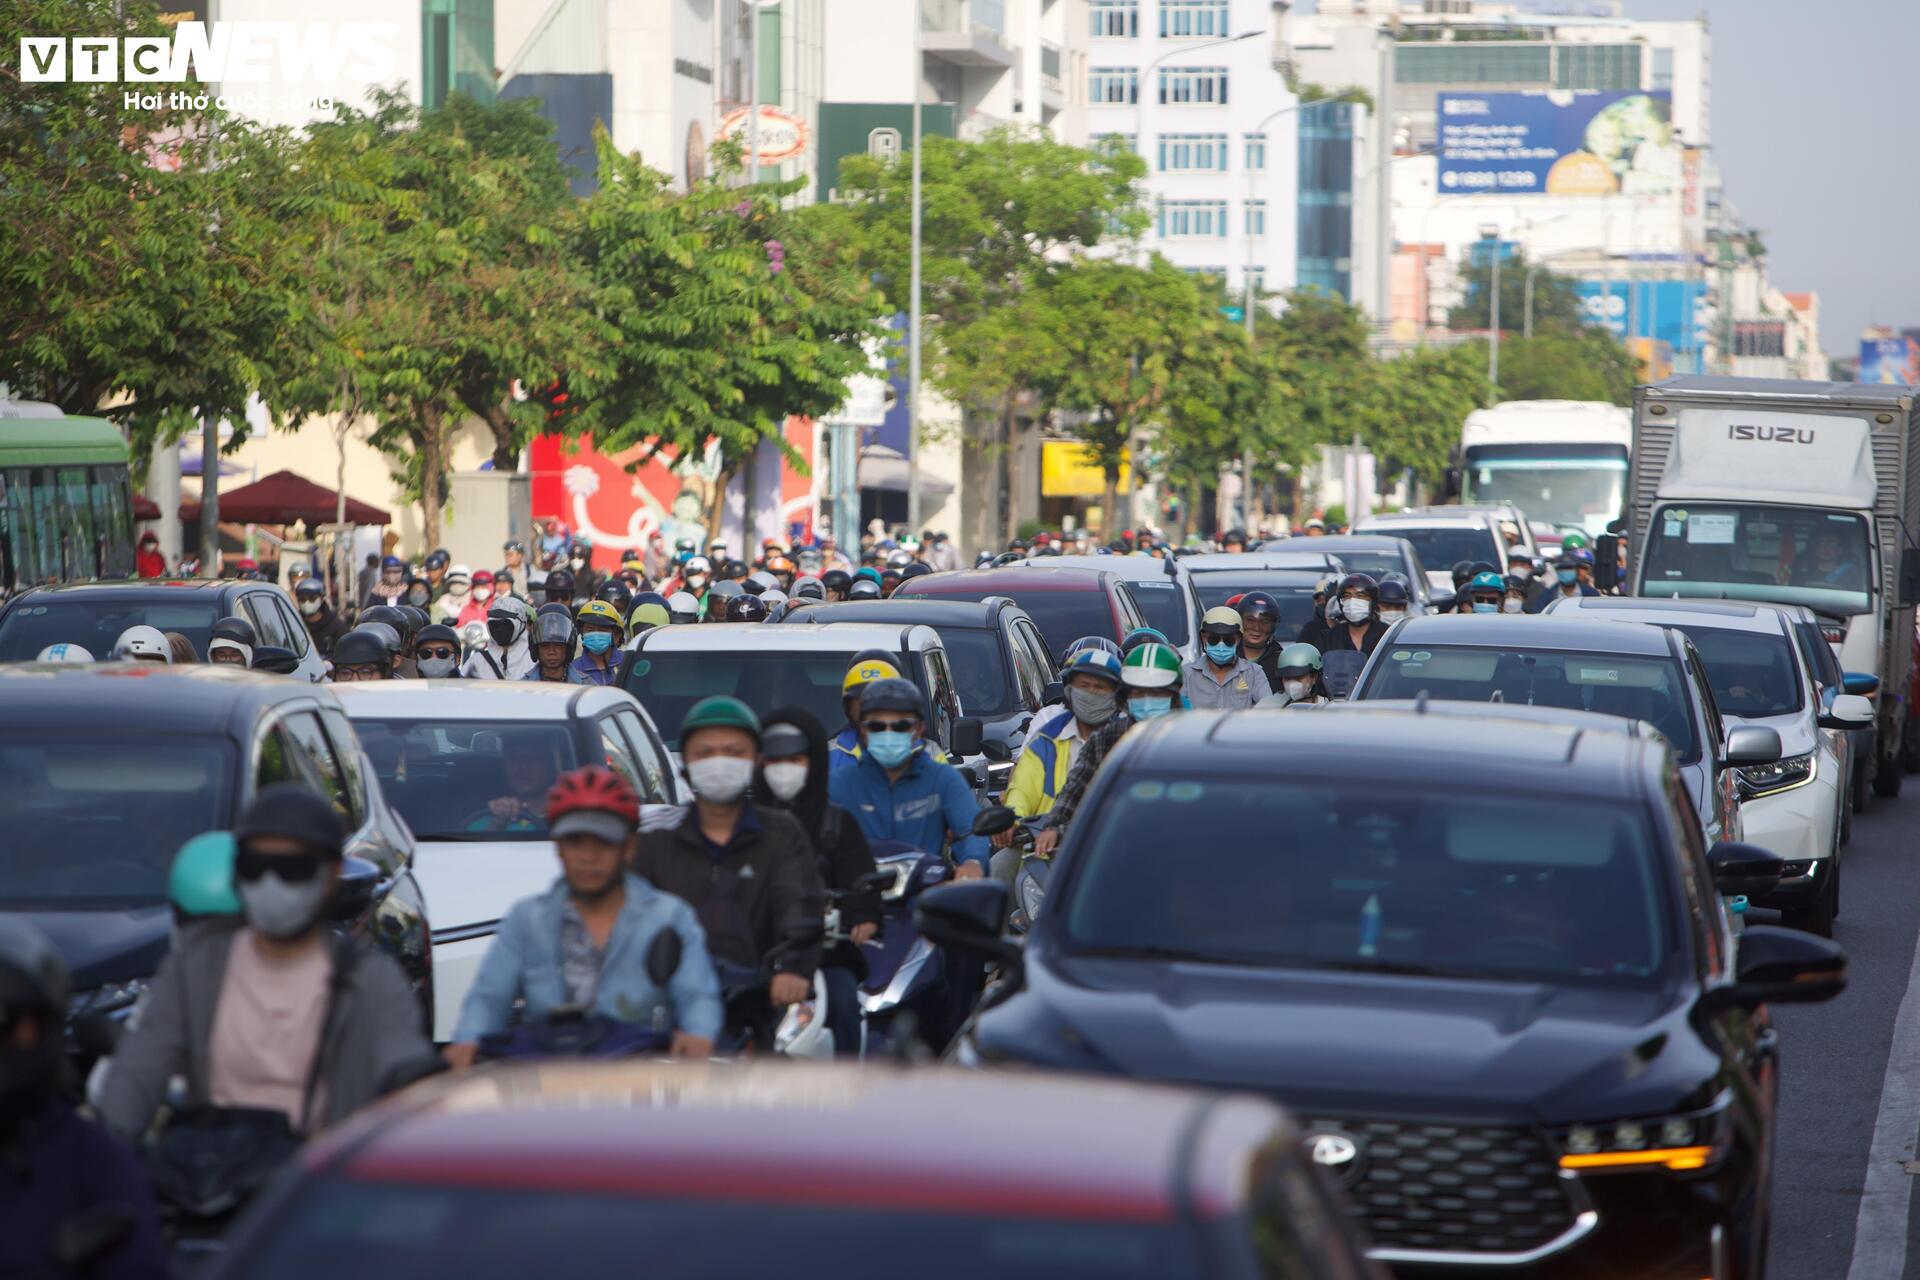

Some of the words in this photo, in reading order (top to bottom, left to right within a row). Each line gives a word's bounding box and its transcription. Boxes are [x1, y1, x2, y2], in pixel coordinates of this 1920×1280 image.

[1728, 425, 1814, 444] ISUZU
[591, 603, 606, 612] be
[861, 667, 880, 680] be
